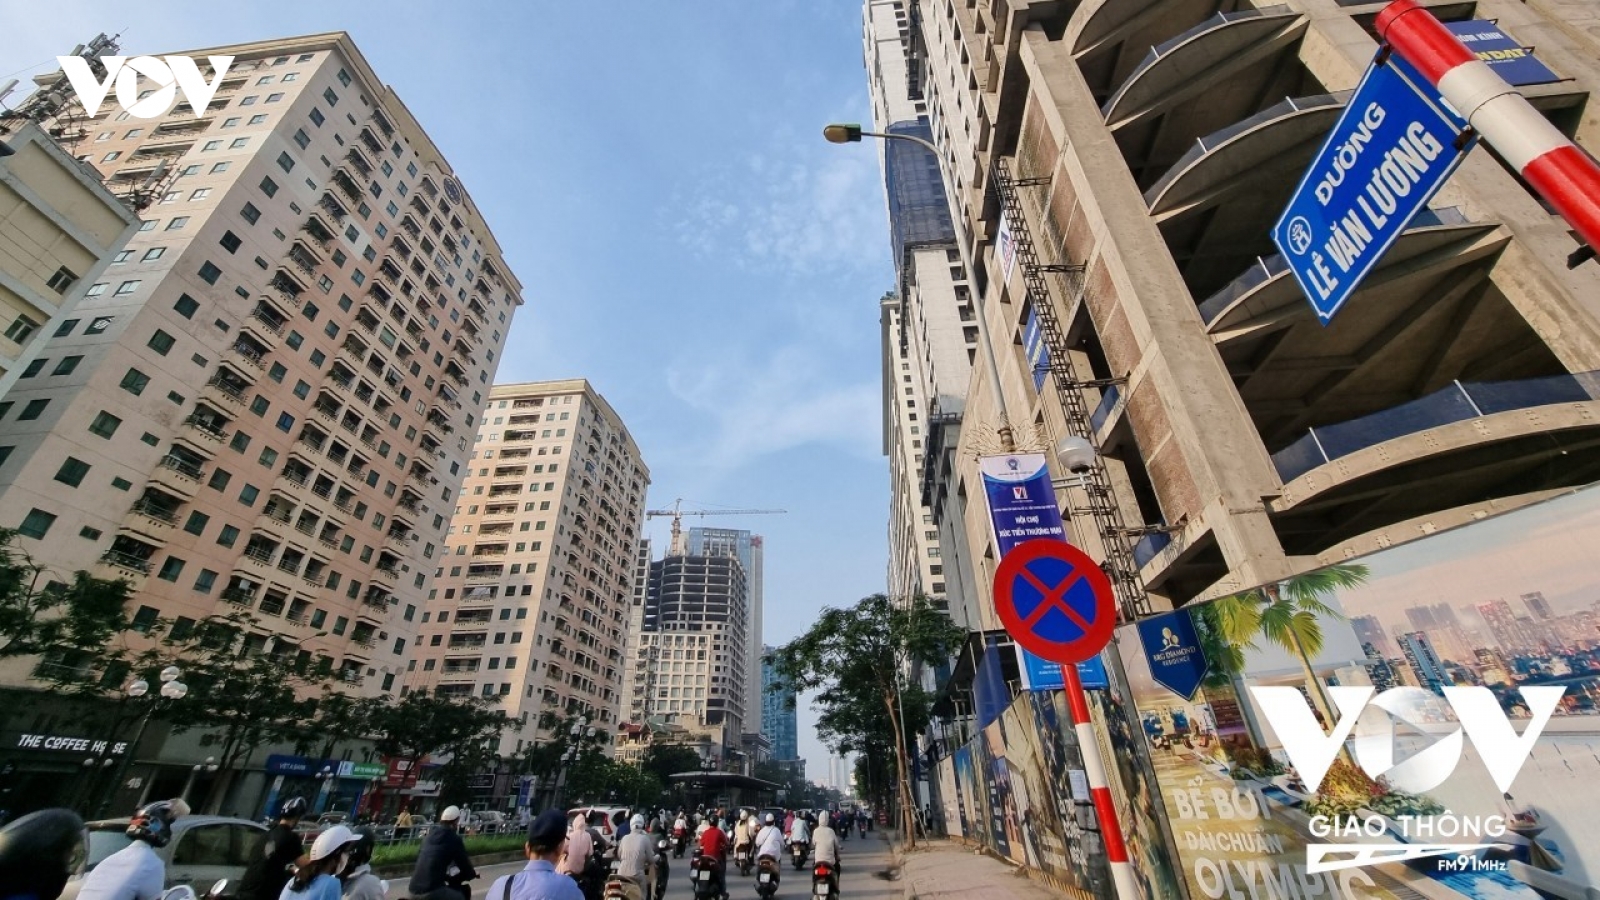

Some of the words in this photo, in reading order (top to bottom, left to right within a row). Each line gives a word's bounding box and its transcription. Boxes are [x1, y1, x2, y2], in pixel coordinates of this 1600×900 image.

[1314, 101, 1387, 206] ĐƯỜNG
[1306, 251, 1340, 300] LÊ
[1324, 209, 1373, 273] VĂN
[1357, 121, 1444, 231] LƯƠNG
[18, 734, 44, 748] THE
[44, 736, 91, 751] COFFEE
[90, 740, 128, 754] HOSE
[1172, 775, 1210, 820] BỂ
[1217, 825, 1285, 854] CHUẨN
